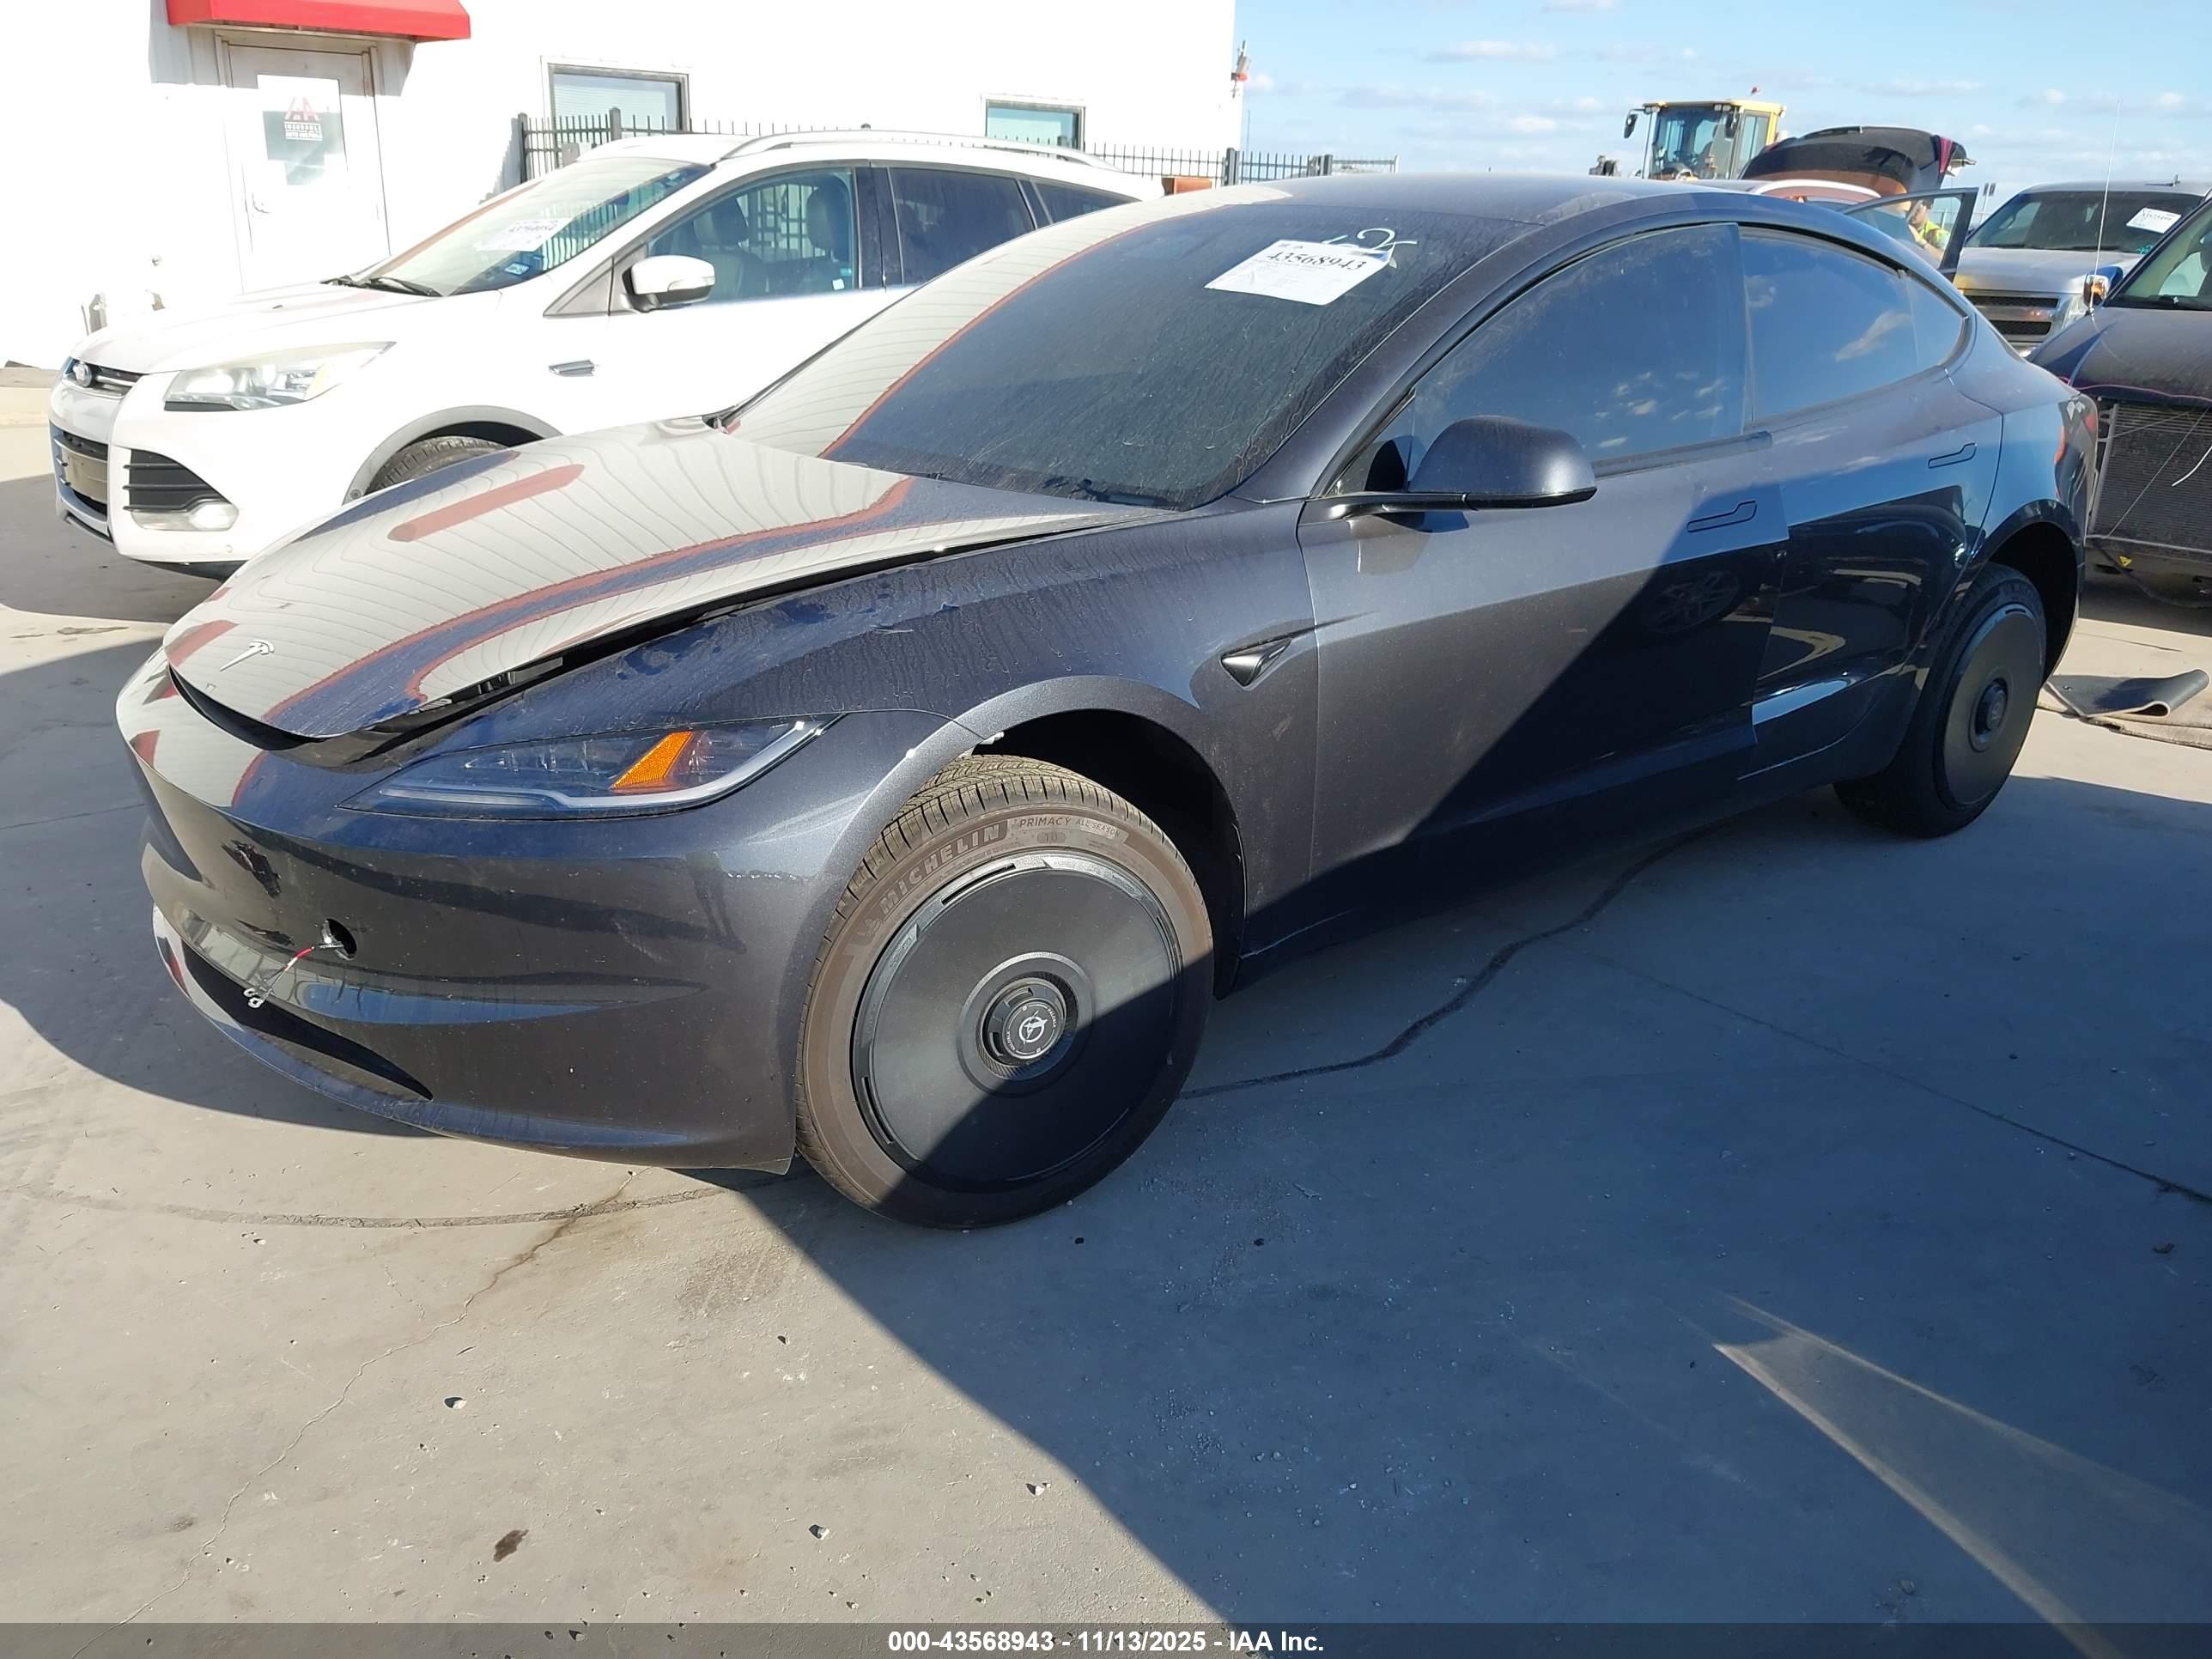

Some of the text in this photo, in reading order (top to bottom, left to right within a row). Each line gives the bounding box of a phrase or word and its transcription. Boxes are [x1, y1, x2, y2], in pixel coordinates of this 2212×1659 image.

[1267, 251, 1367, 270] 43568943
[1019, 816, 1121, 838] PRIMACY ALL SEASON
[880, 823, 1000, 914] MICHELIN
